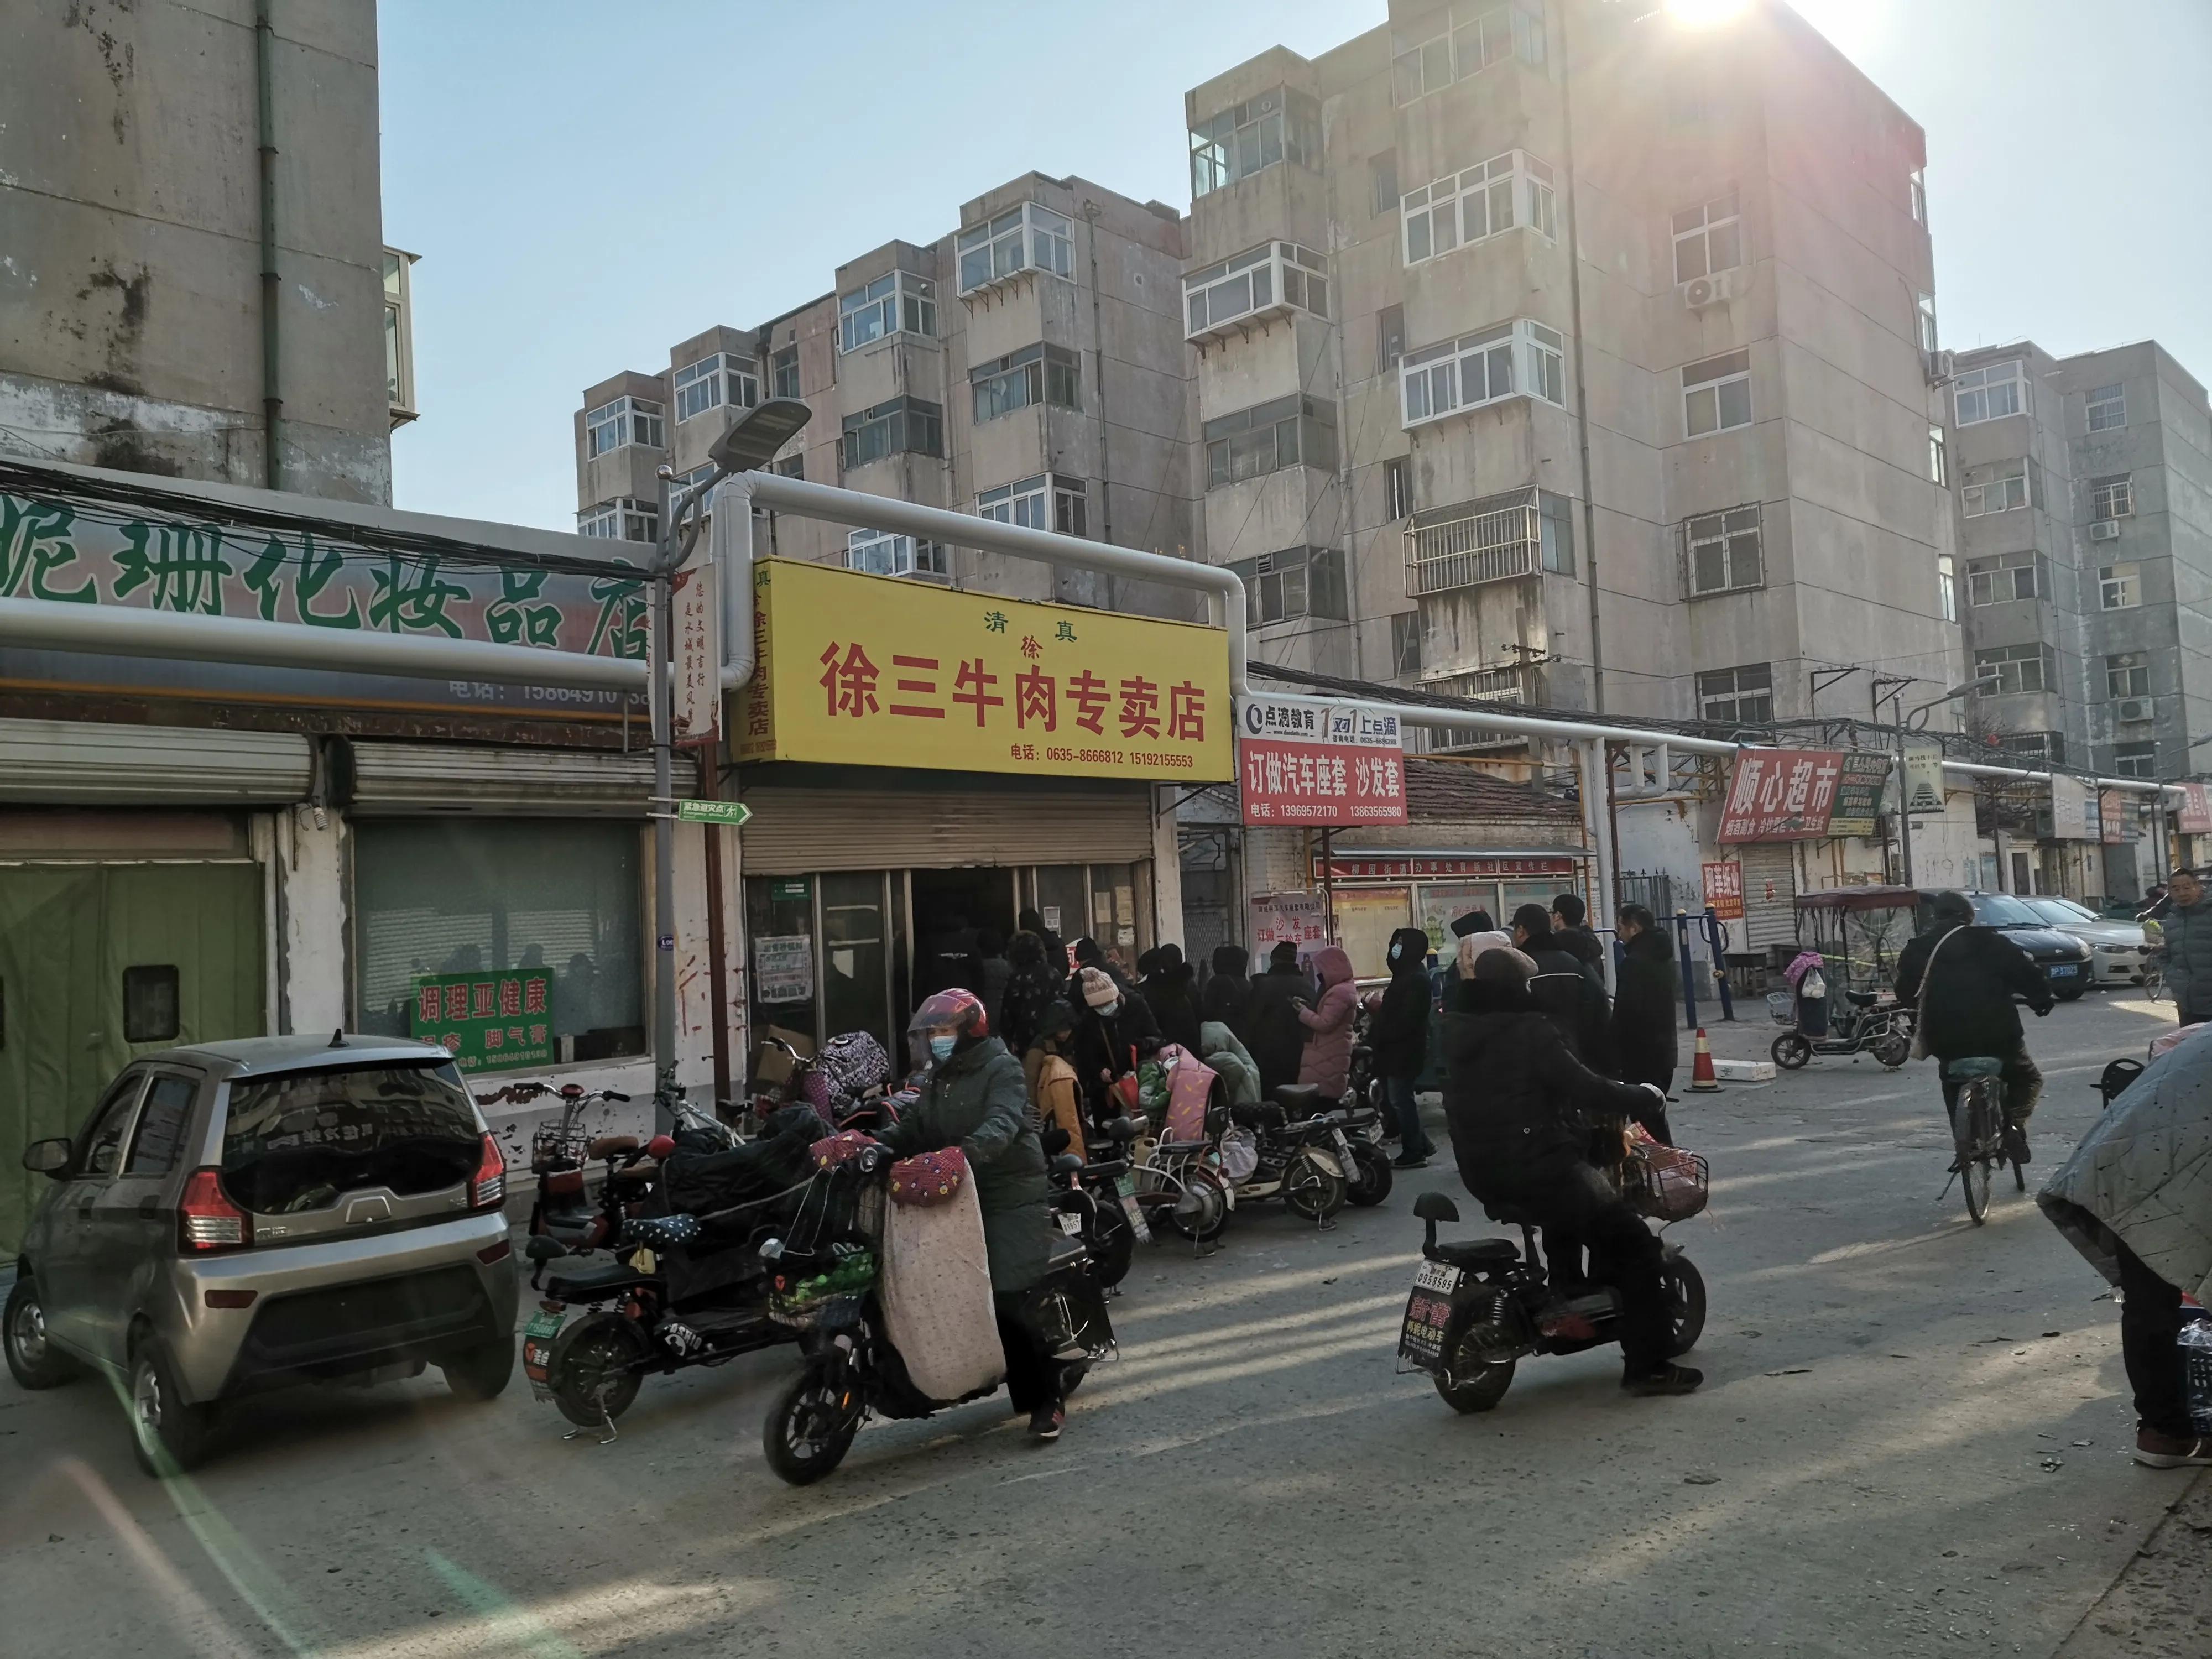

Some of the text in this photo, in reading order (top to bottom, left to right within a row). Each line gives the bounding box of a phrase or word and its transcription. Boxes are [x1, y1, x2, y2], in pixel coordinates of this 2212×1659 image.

[1021, 635, 1044, 660] 徐
[820, 641, 1206, 742] 徐三牛肉专卖店
[1011, 744, 1194, 768] 电话: 0635-8666812 15192155553
[1248, 750, 1400, 797] 订做汽车座套 沙发套
[1729, 758, 1837, 815] 顺心超市
[1251, 802, 1402, 817] 电话: 13969572170 13863565980
[419, 977, 547, 1023] 调理亚健康
[484, 1024, 547, 1049] 脚气膏
